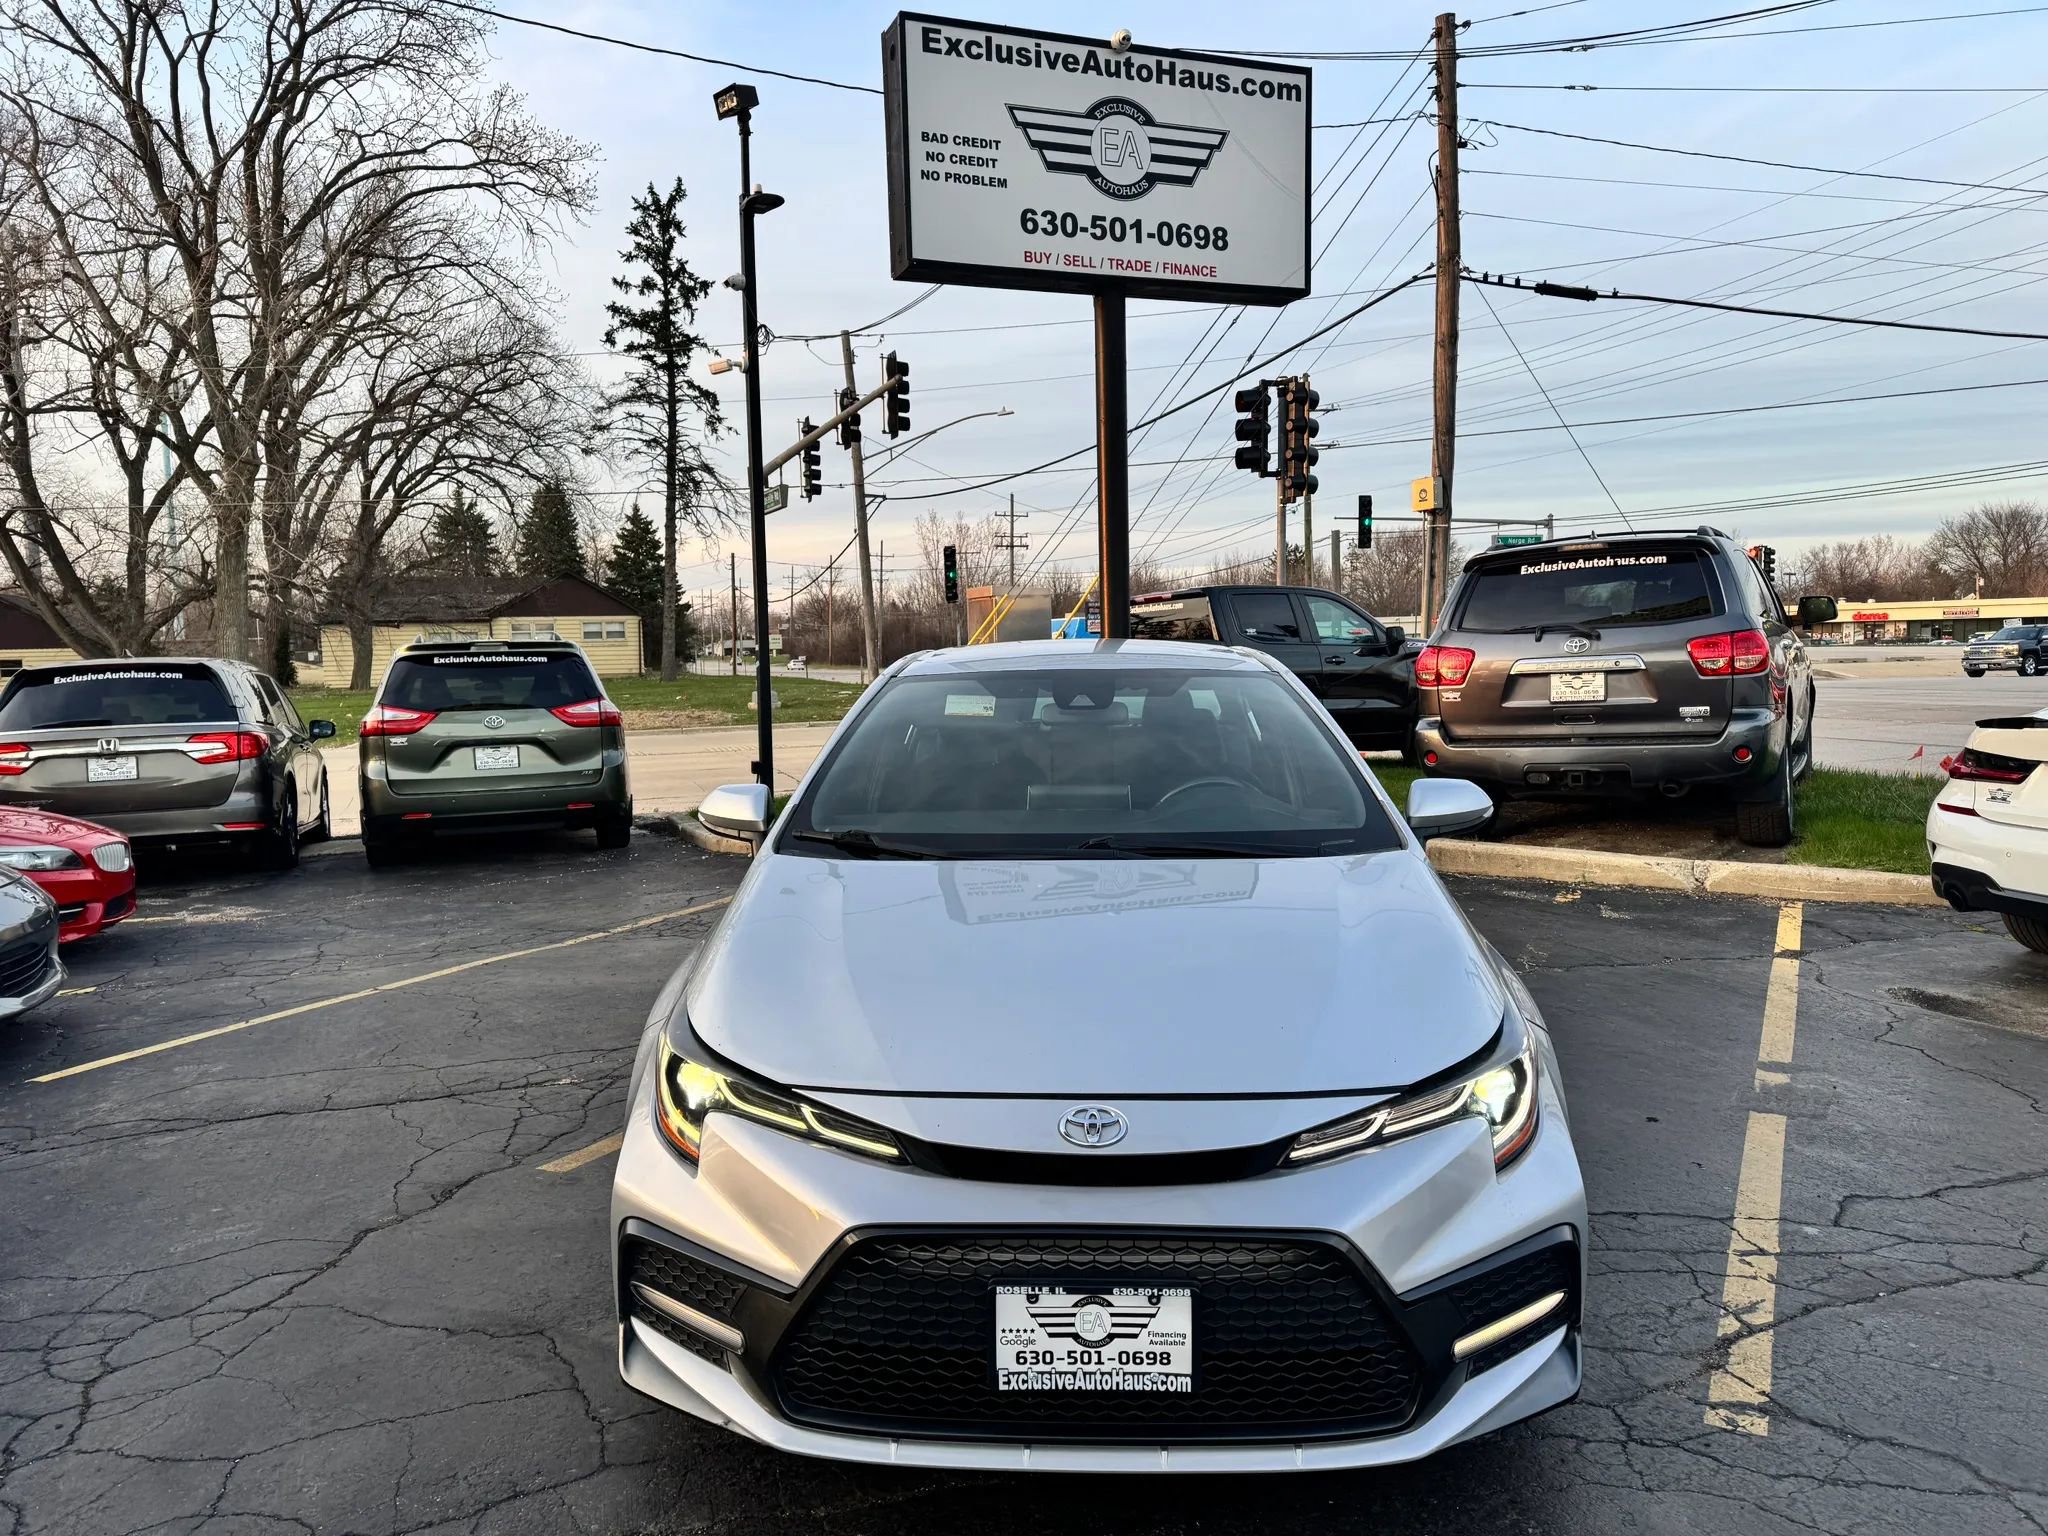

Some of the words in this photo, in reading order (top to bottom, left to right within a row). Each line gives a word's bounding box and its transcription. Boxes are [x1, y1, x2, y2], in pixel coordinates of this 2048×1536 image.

[921, 26, 1302, 103] ExclusiveAutoHaus.com
[1094, 103, 1146, 125] EXCLUSIVE
[921, 131, 949, 145] BAD
[952, 135, 1002, 151] CREDIT
[1100, 127, 1144, 170] EA
[925, 151, 946, 163] NO
[949, 153, 998, 169] CREDIT
[920, 169, 941, 182] NO
[944, 171, 1008, 189] PROBLEM
[1093, 176, 1149, 196] AUTOHAUS
[1020, 207, 1229, 252] 630-501-0698
[1023, 250, 1052, 265] BUY
[1063, 254, 1097, 269] SELL
[1107, 257, 1152, 273] TRADE
[1162, 262, 1218, 278] FINANCE
[433, 655, 548, 664] ExclusiveAutohaus.com
[53, 670, 183, 685] ExclusiveAutohaus.com
[1055, 1286, 1067, 1295] IL
[1112, 1287, 1191, 1297] 630-501-0698
[1080, 1312, 1107, 1333] EA
[999, 1335, 1037, 1348] Google
[1147, 1330, 1187, 1340] Financing
[1015, 1350, 1172, 1366] 630-501-0698
[997, 1368, 1192, 1393] ExclusiveAutoHaus.com
